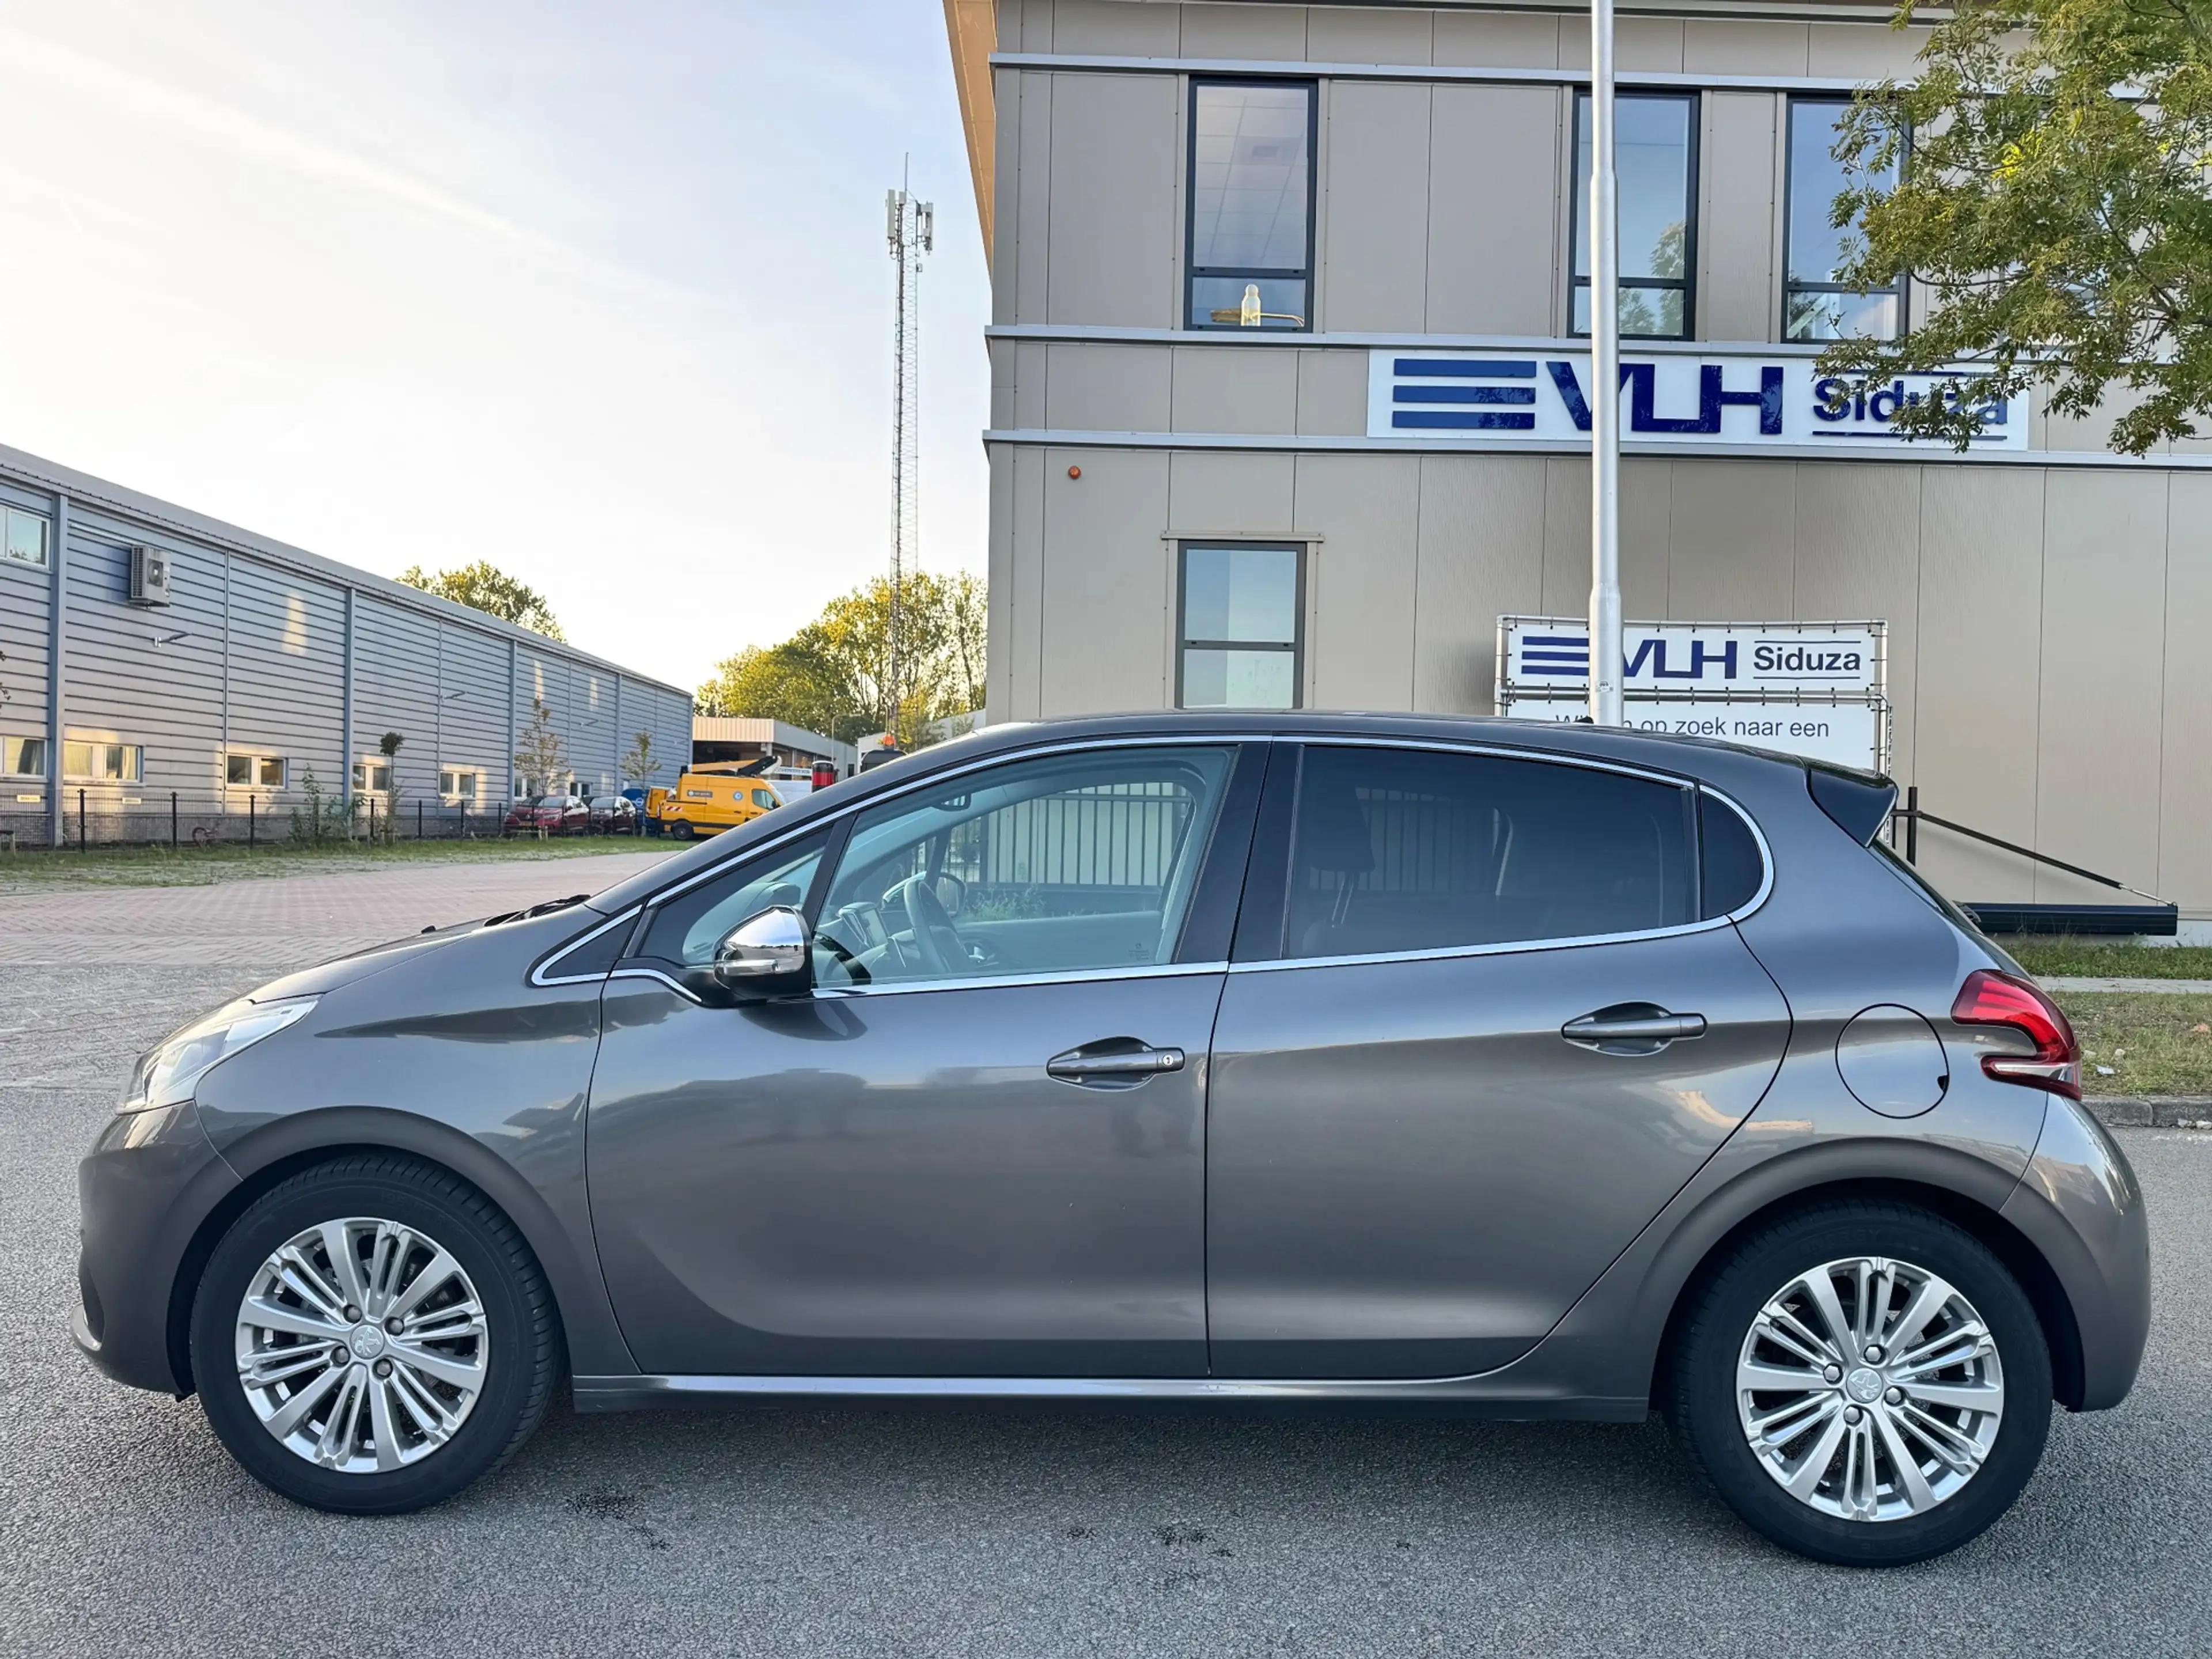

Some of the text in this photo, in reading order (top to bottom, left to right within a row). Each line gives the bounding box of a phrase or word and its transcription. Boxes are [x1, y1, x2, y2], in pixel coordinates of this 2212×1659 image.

[1813, 378, 2008, 425] Sida
[1753, 646, 1860, 671] Siduza
[1675, 717, 1726, 735] zoek
[1734, 721, 1783, 736] naar
[1790, 722, 1828, 737] een
